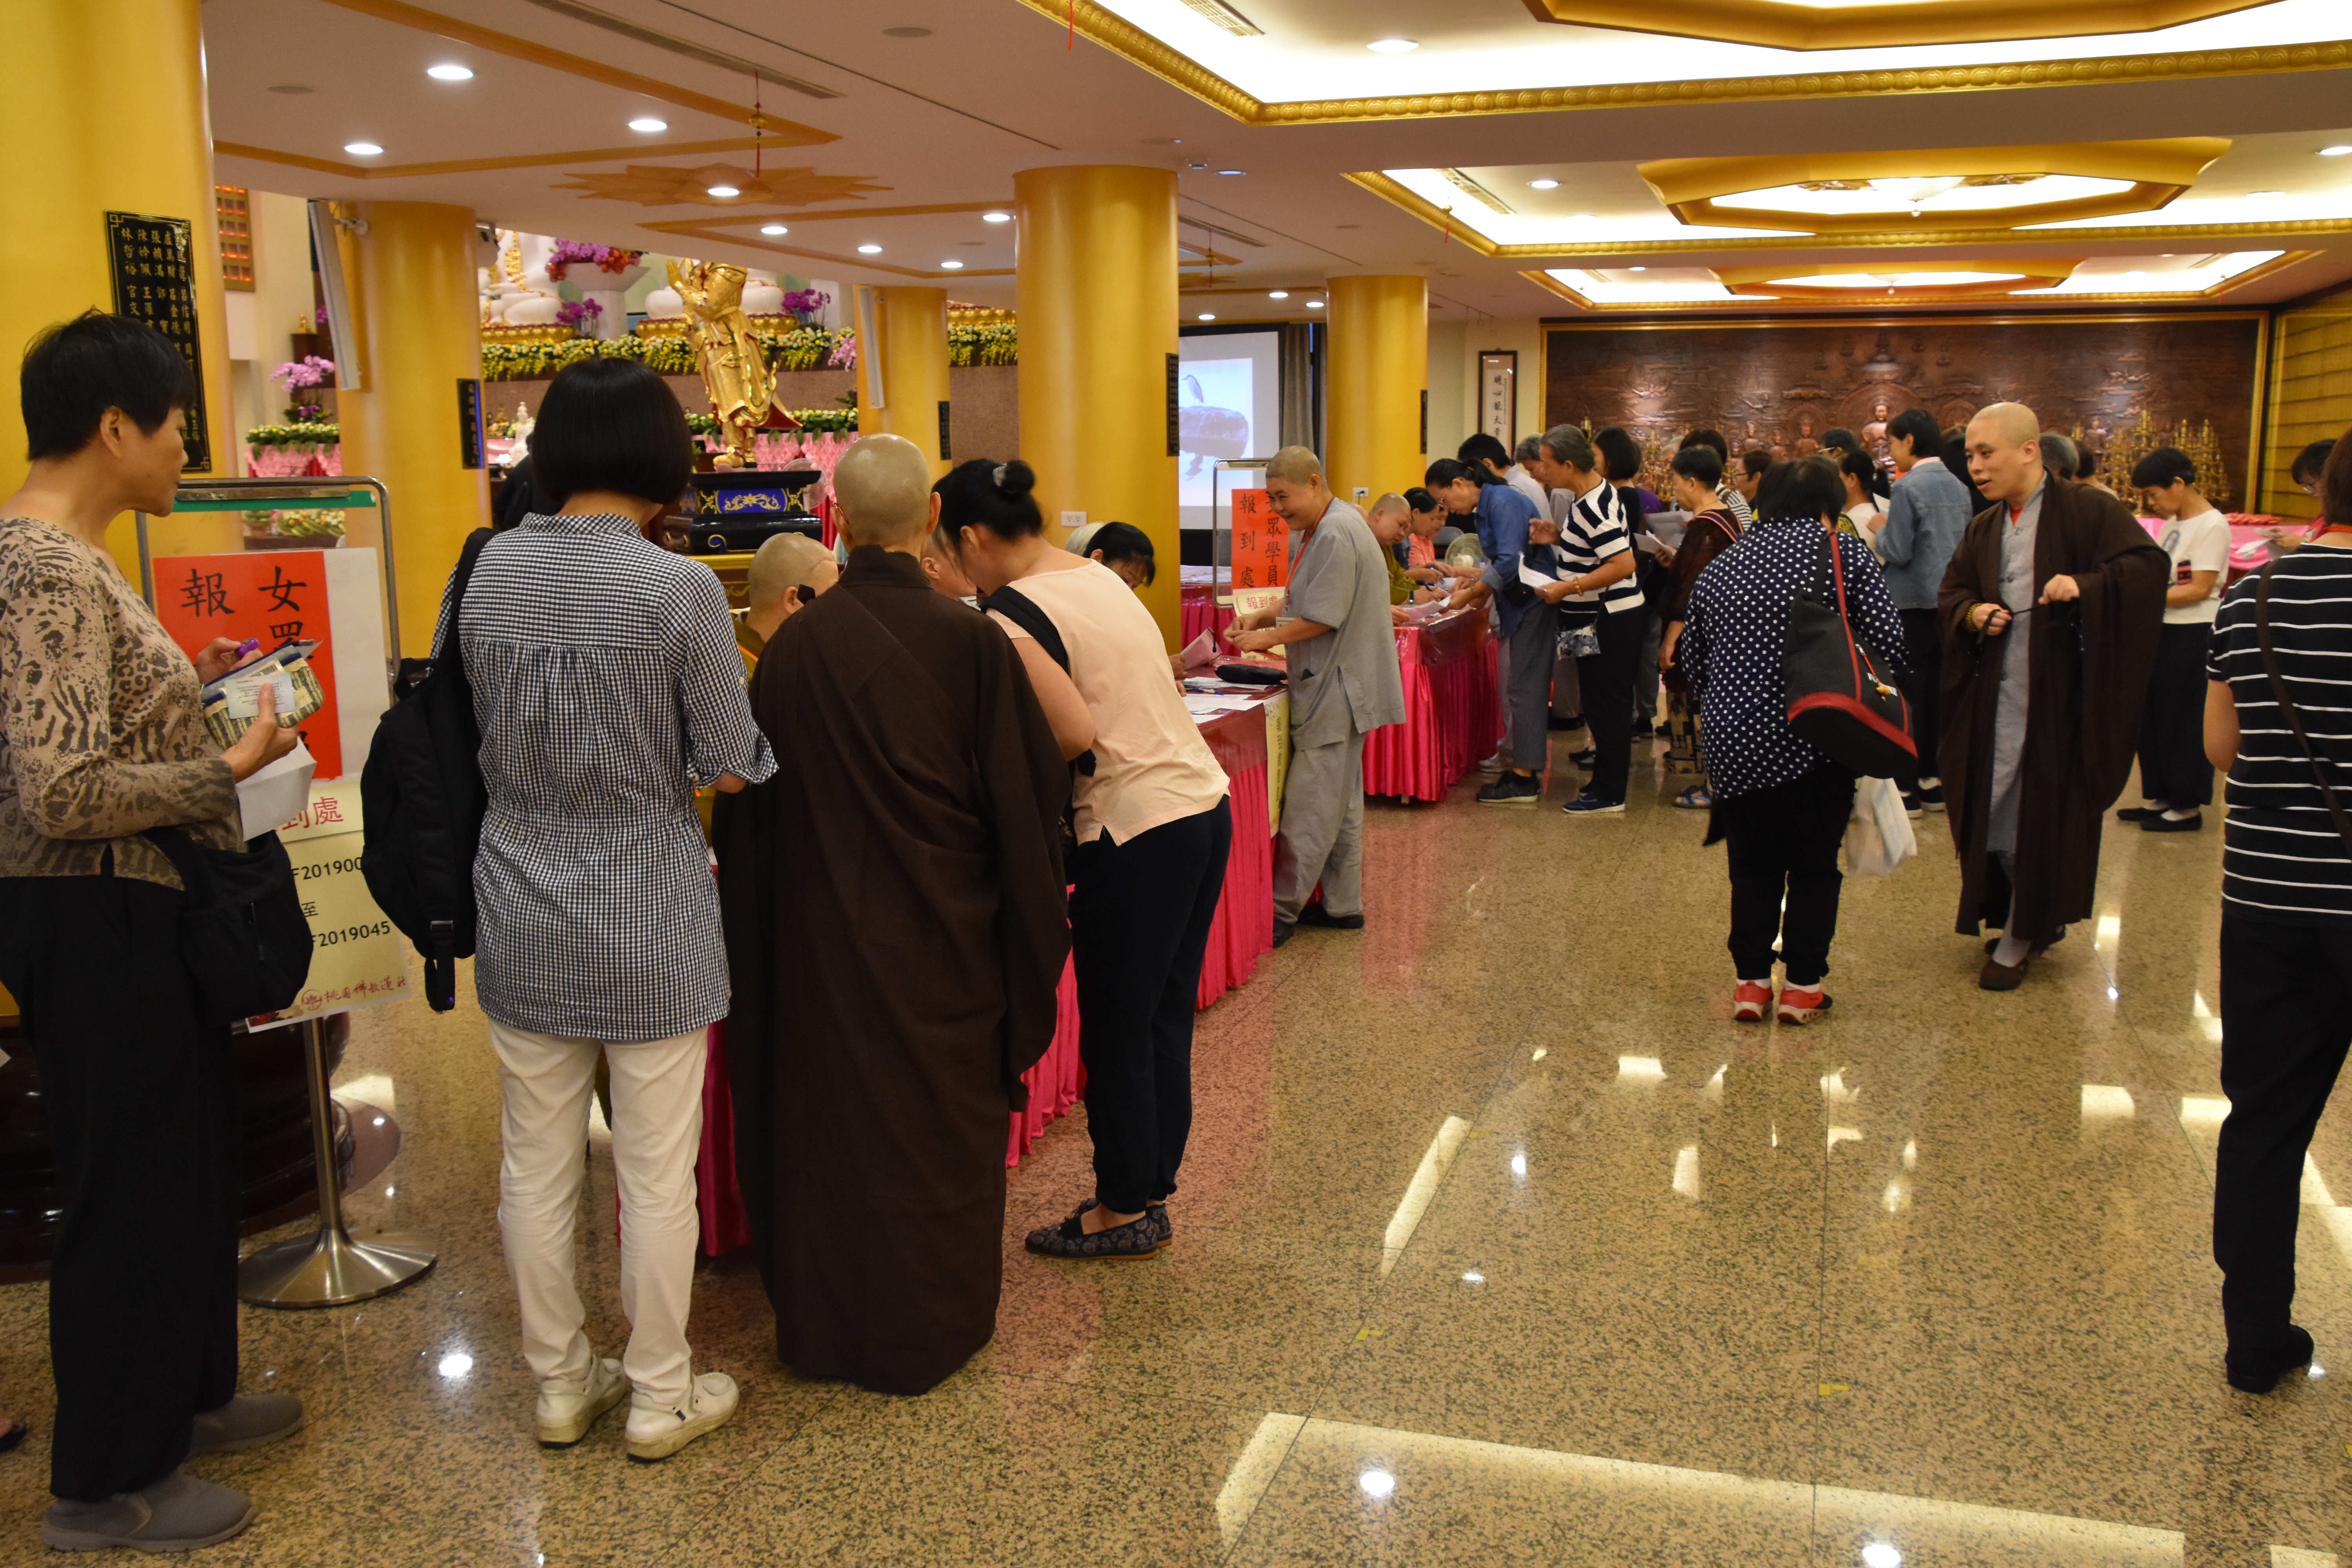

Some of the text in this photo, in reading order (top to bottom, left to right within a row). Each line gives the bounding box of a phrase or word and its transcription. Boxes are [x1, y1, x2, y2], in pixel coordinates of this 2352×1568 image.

[1240, 493, 1257, 588] 報到處
[180, 568, 235, 618] 報
[274, 795, 344, 832] 到處
[301, 901, 318, 917] 至
